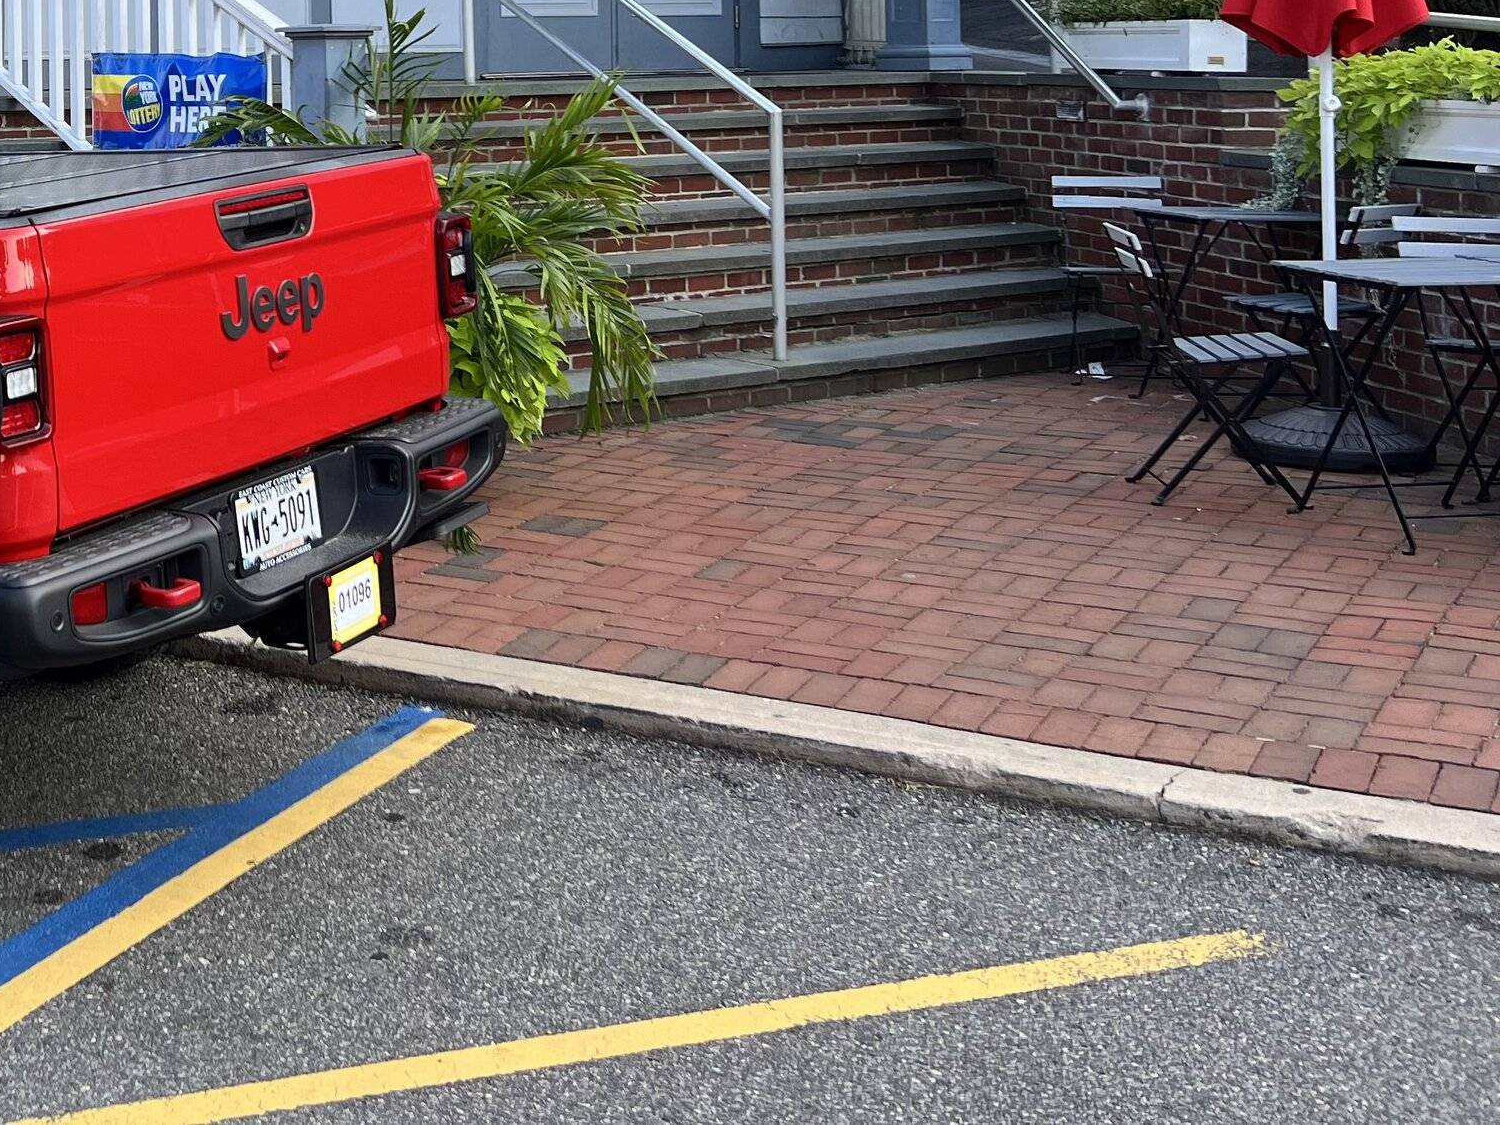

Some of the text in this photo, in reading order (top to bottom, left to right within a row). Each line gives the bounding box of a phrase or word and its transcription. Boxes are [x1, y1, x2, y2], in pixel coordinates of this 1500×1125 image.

[168, 74, 227, 102] PLAY
[127, 104, 161, 126] LOTTERY
[170, 106, 227, 133] HER
[220, 272, 324, 340] Jeep
[239, 486, 253, 498] EAST
[253, 480, 273, 493] COAST
[259, 559, 276, 571] AUTO
[339, 578, 372, 613] 01096
